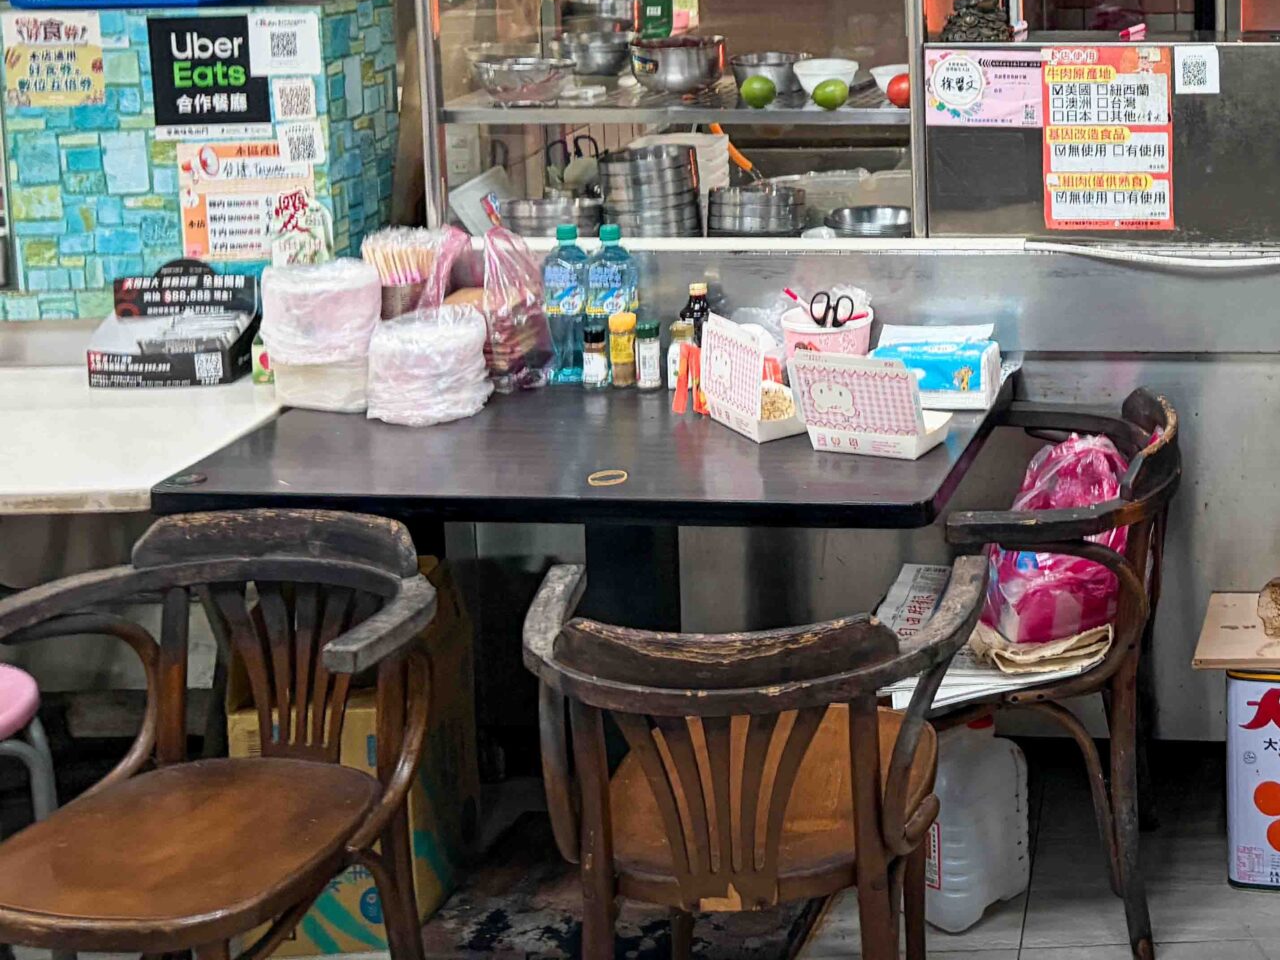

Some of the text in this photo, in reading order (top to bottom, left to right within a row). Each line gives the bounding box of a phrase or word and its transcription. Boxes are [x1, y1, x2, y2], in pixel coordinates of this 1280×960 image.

[170, 31, 243, 60] Uber
[173, 61, 247, 88] Eats
[1047, 67, 1112, 81] 牛肉原產地
[1065, 84, 1149, 96] 美國 紐西蘭
[176, 93, 248, 114] 合作餐廳
[1065, 97, 1092, 110] 澳洲
[1066, 110, 1136, 122] 日本 其他
[1048, 128, 1126, 141] 基因改造食品
[1068, 144, 1165, 157] 無使用 有使用
[1050, 174, 1149, 189] 組肉(僅供熟食)
[1069, 191, 1166, 204] 無使用 有使用
